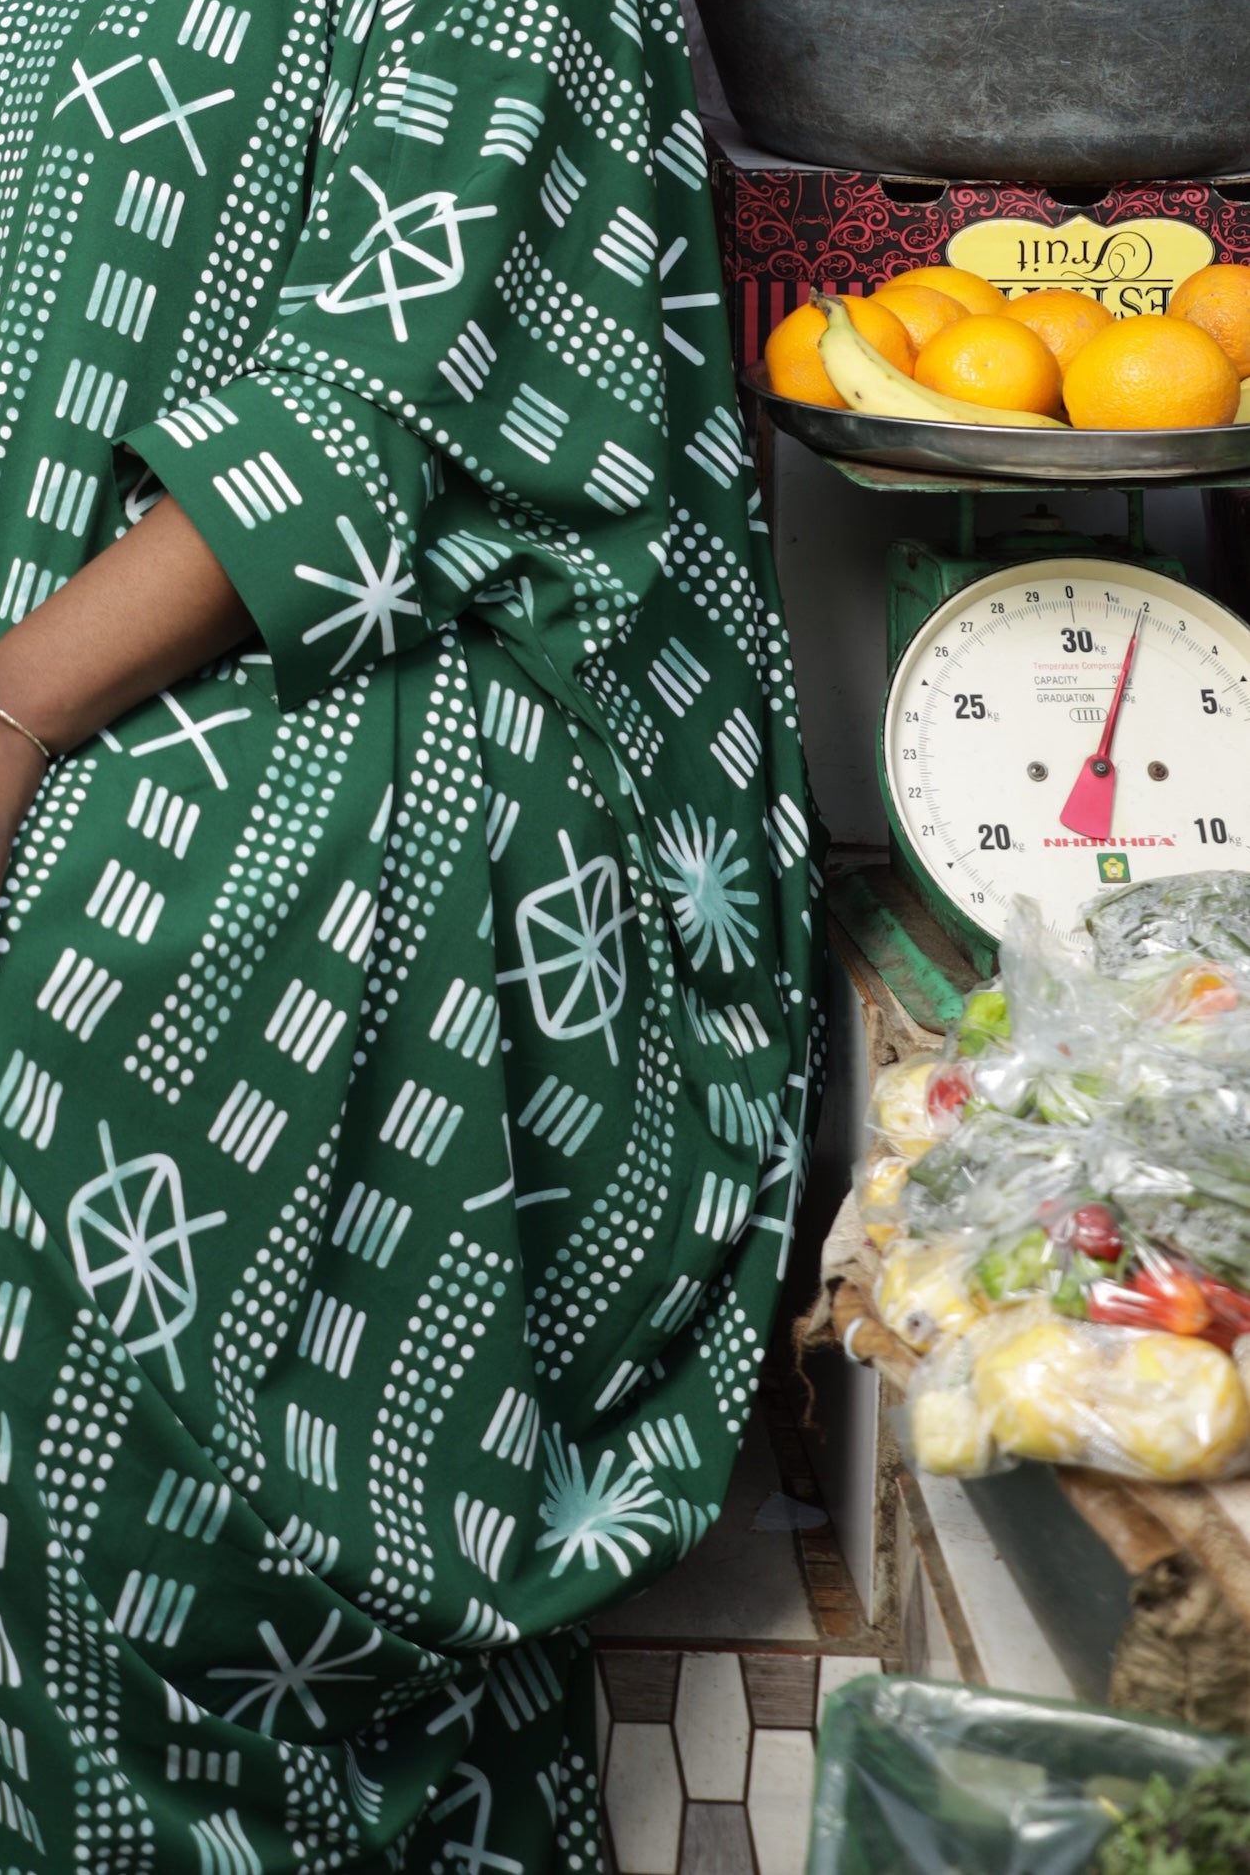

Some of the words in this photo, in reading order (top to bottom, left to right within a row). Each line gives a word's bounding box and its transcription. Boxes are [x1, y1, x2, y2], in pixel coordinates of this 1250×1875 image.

[1016, 231, 1153, 283] Fruit
[1025, 591, 1040, 603] 29
[1065, 586, 1074, 599] 0
[990, 602, 1005, 614] 28
[1142, 601, 1150, 613] 2
[960, 621, 974, 633] 27
[1178, 620, 1186, 632] 3
[934, 646, 949, 658] 26
[1211, 645, 1219, 656] 4
[1033, 662, 1079, 671] Temperature
[1034, 676, 1078, 686] CAPACITY
[1036, 693, 1095, 703] GRADUATION
[905, 711, 920, 723] 24
[902, 749, 917, 760] 23
[907, 787, 922, 799] 22
[921, 825, 935, 836] 21
[969, 892, 985, 904] 19
